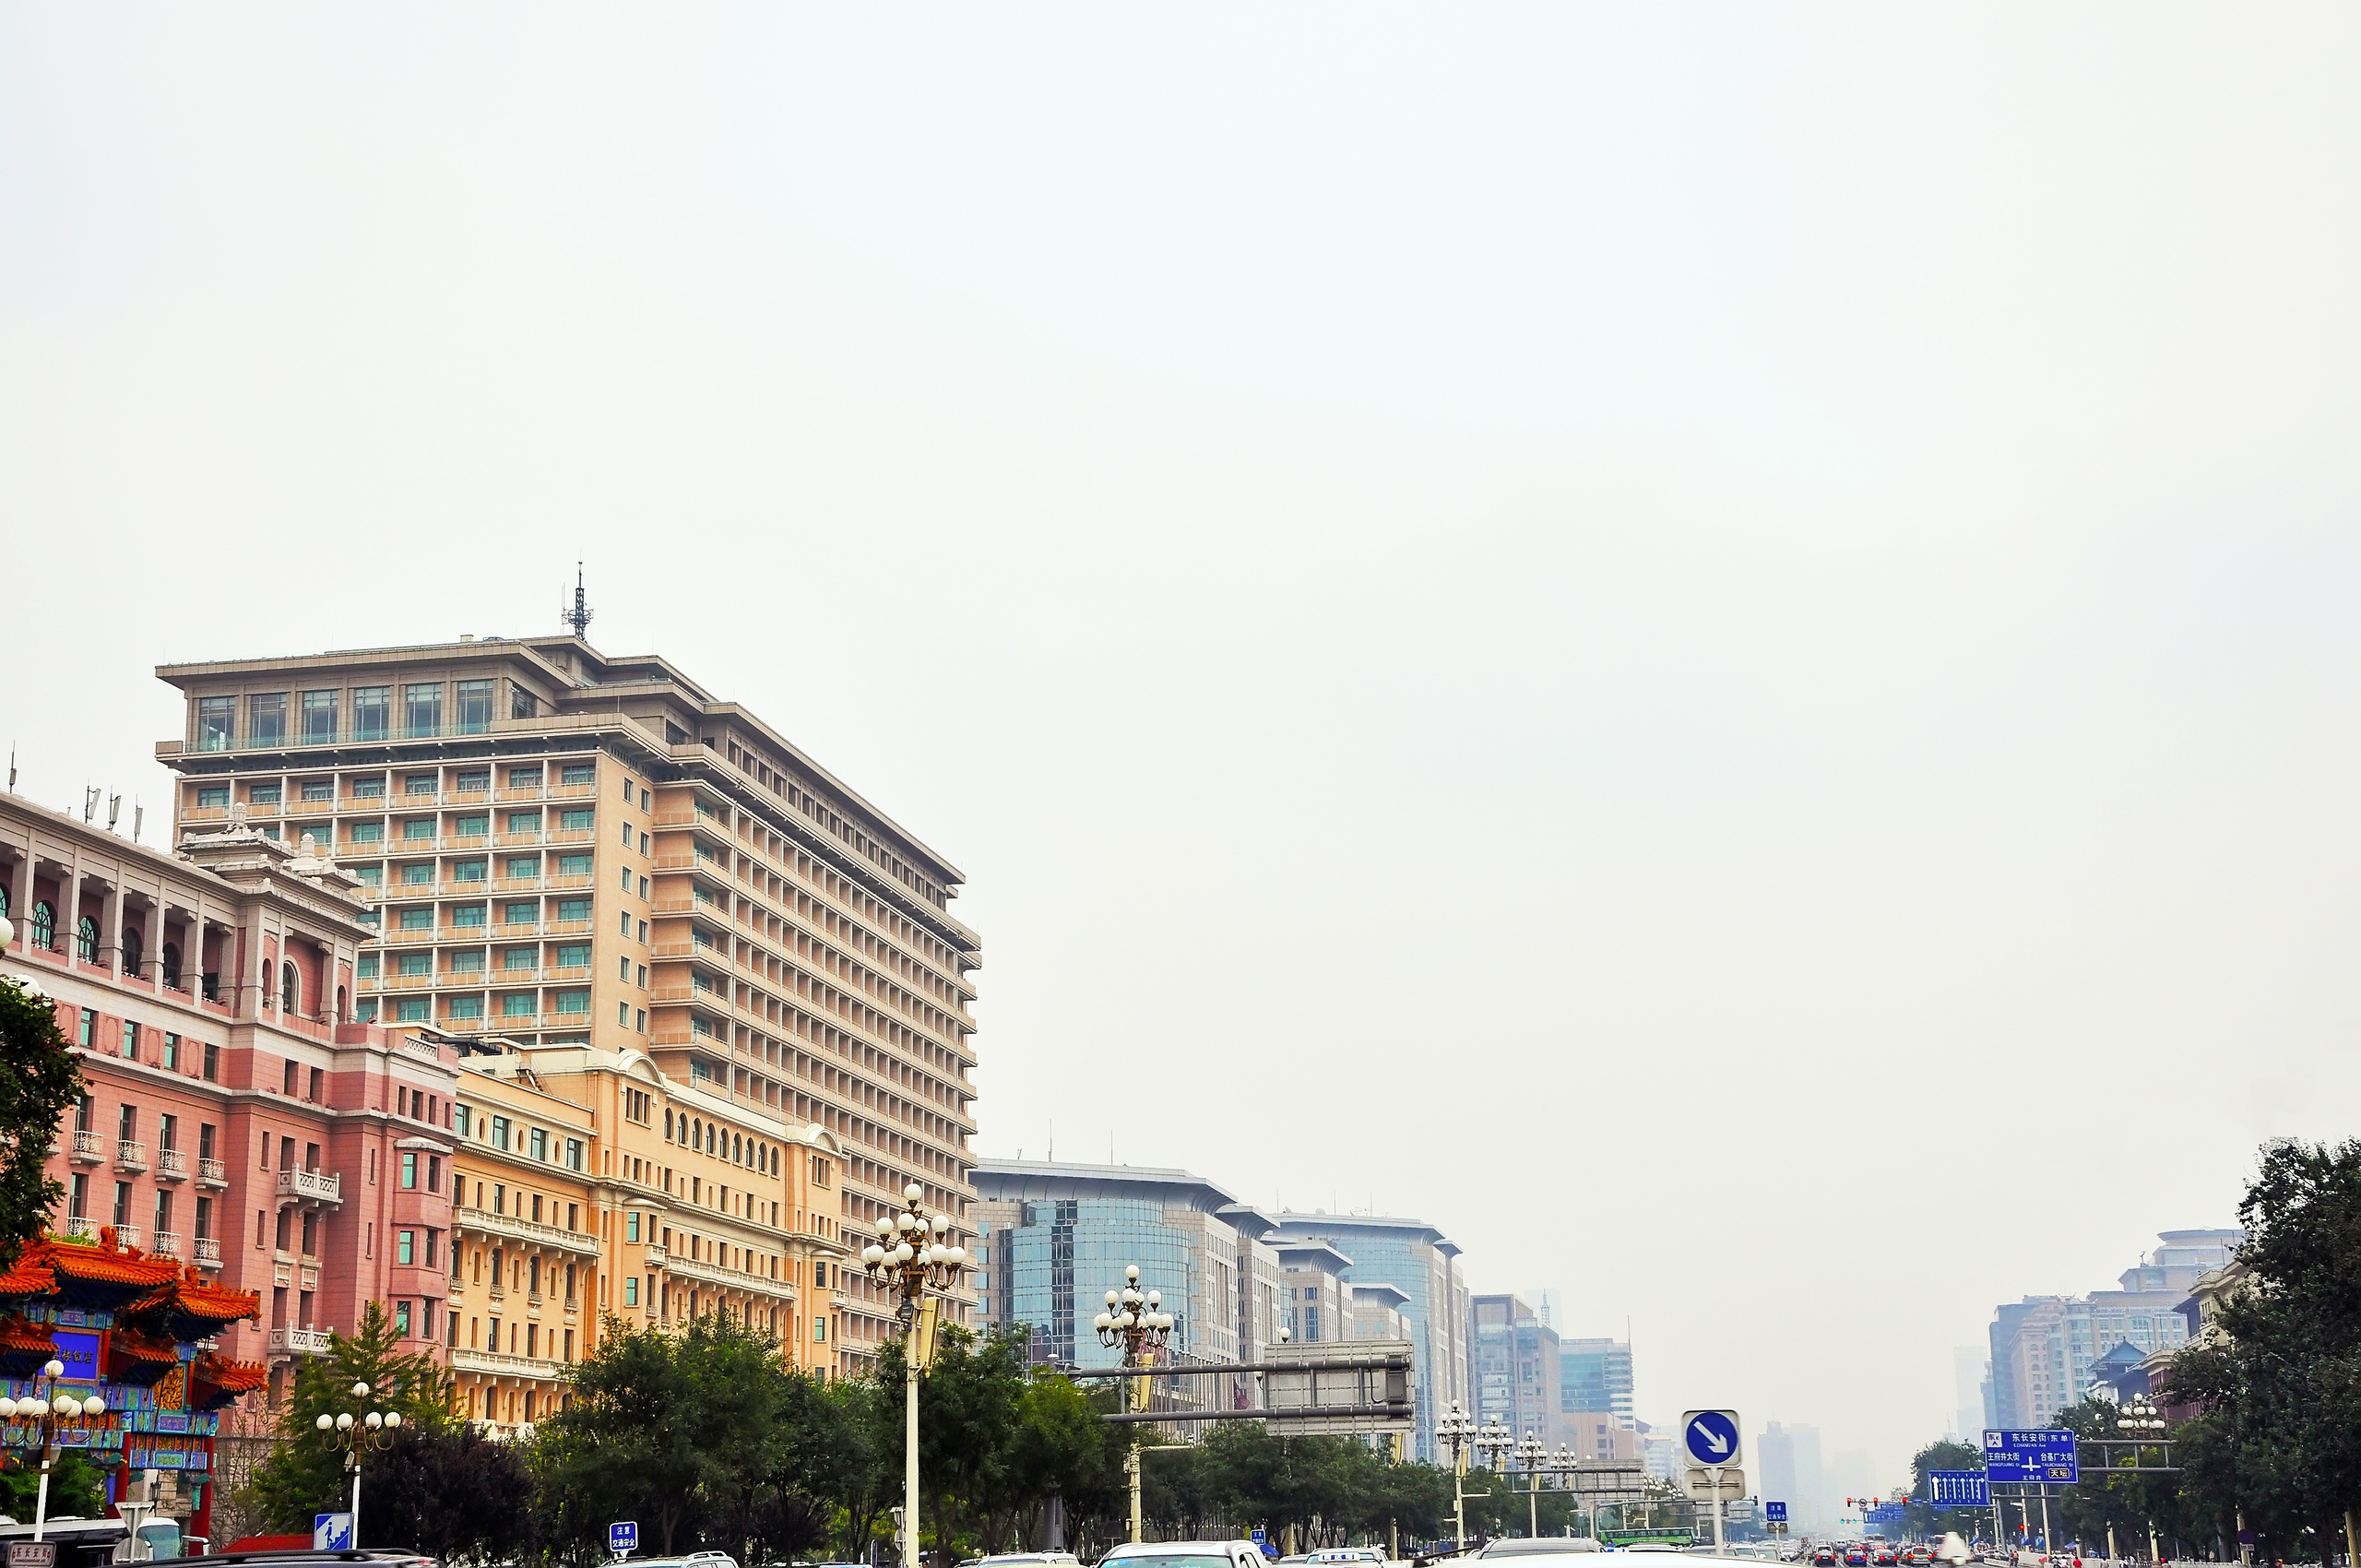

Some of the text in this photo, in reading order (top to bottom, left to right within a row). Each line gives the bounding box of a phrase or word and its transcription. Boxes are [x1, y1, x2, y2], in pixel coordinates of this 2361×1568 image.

[1987, 1453, 2020, 1461] 王府井大街
[2040, 1453, 2073, 1461] 台基厂大街
[617, 1526, 630, 1535] 注意
[612, 1538, 635, 1547] 交通安全
